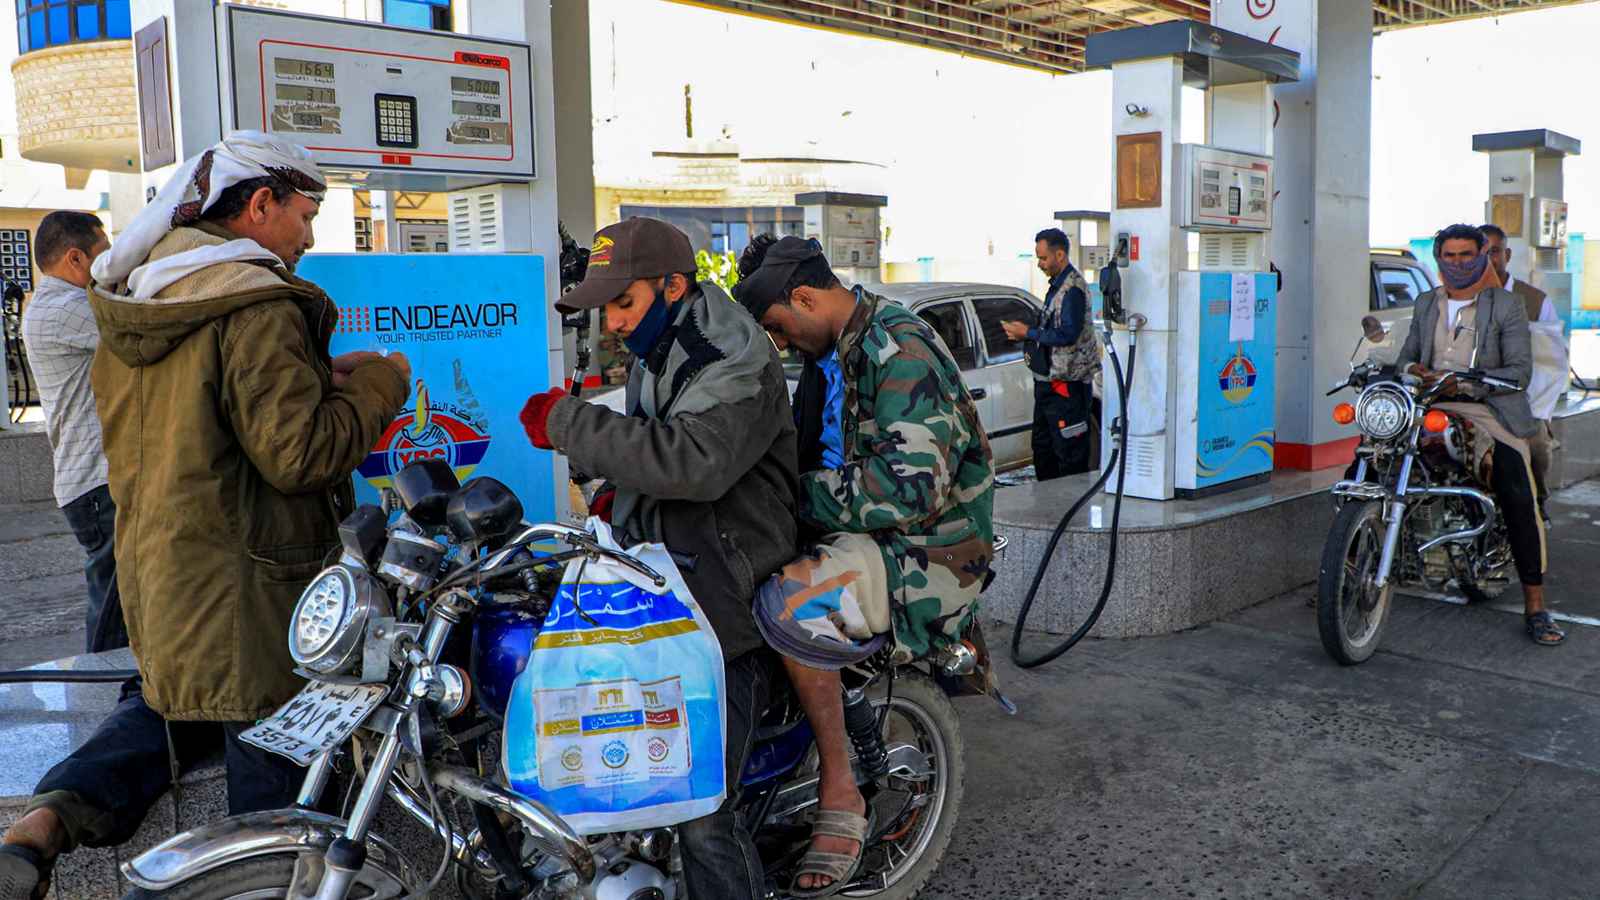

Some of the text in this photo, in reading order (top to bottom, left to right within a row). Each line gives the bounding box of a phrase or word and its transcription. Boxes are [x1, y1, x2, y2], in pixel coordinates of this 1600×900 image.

[374, 303, 517, 332] ENDEAVOR
[376, 329, 502, 344] YOUR TRUSTED PARTNER
[252, 726, 306, 751] 3573
